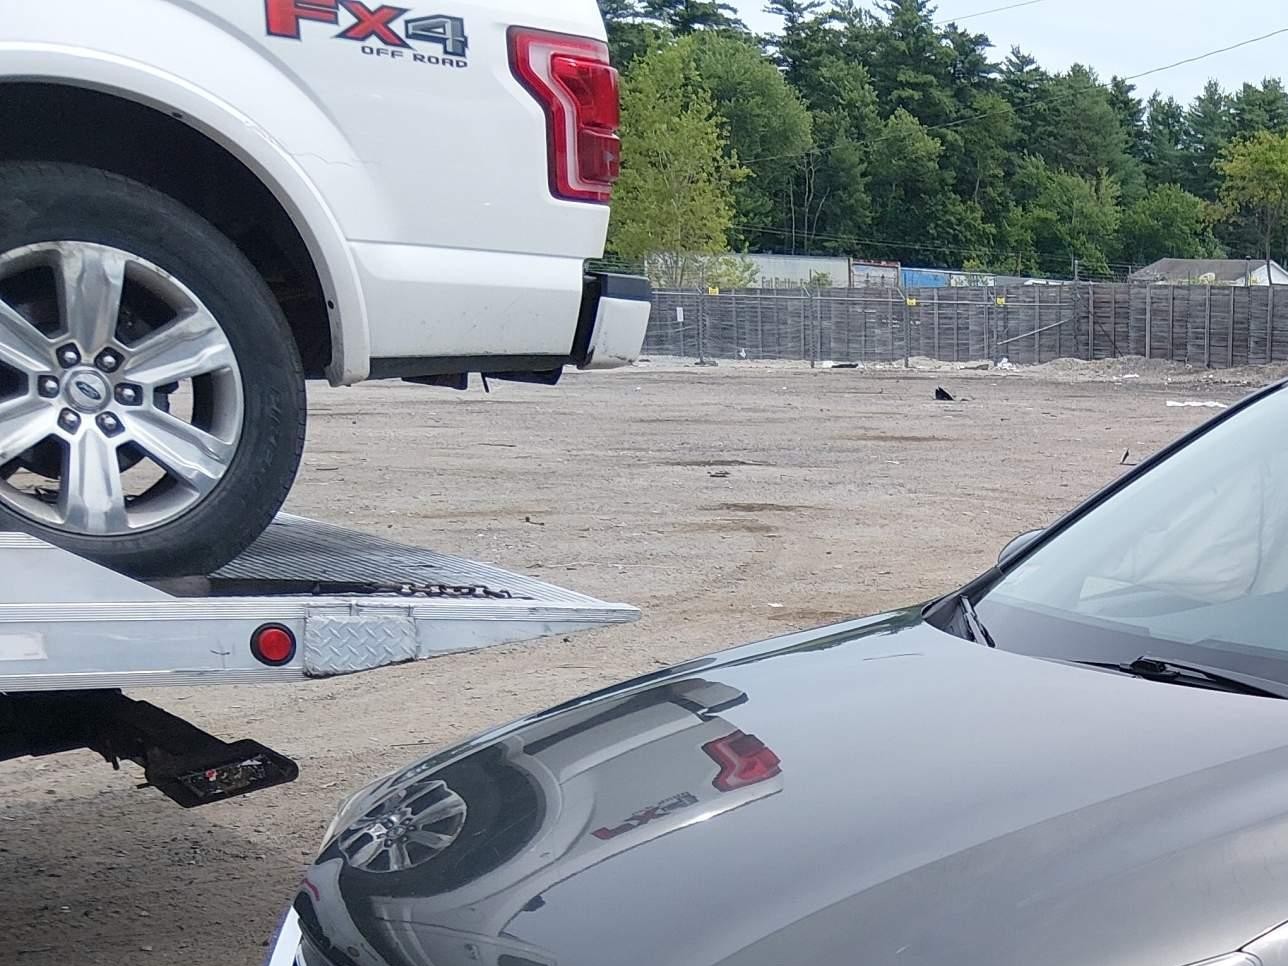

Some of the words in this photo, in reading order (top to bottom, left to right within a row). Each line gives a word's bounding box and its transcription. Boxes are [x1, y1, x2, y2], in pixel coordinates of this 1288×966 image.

[264, 0, 468, 57] FX4
[361, 46, 404, 58] OFF
[413, 52, 468, 68] ROAD
